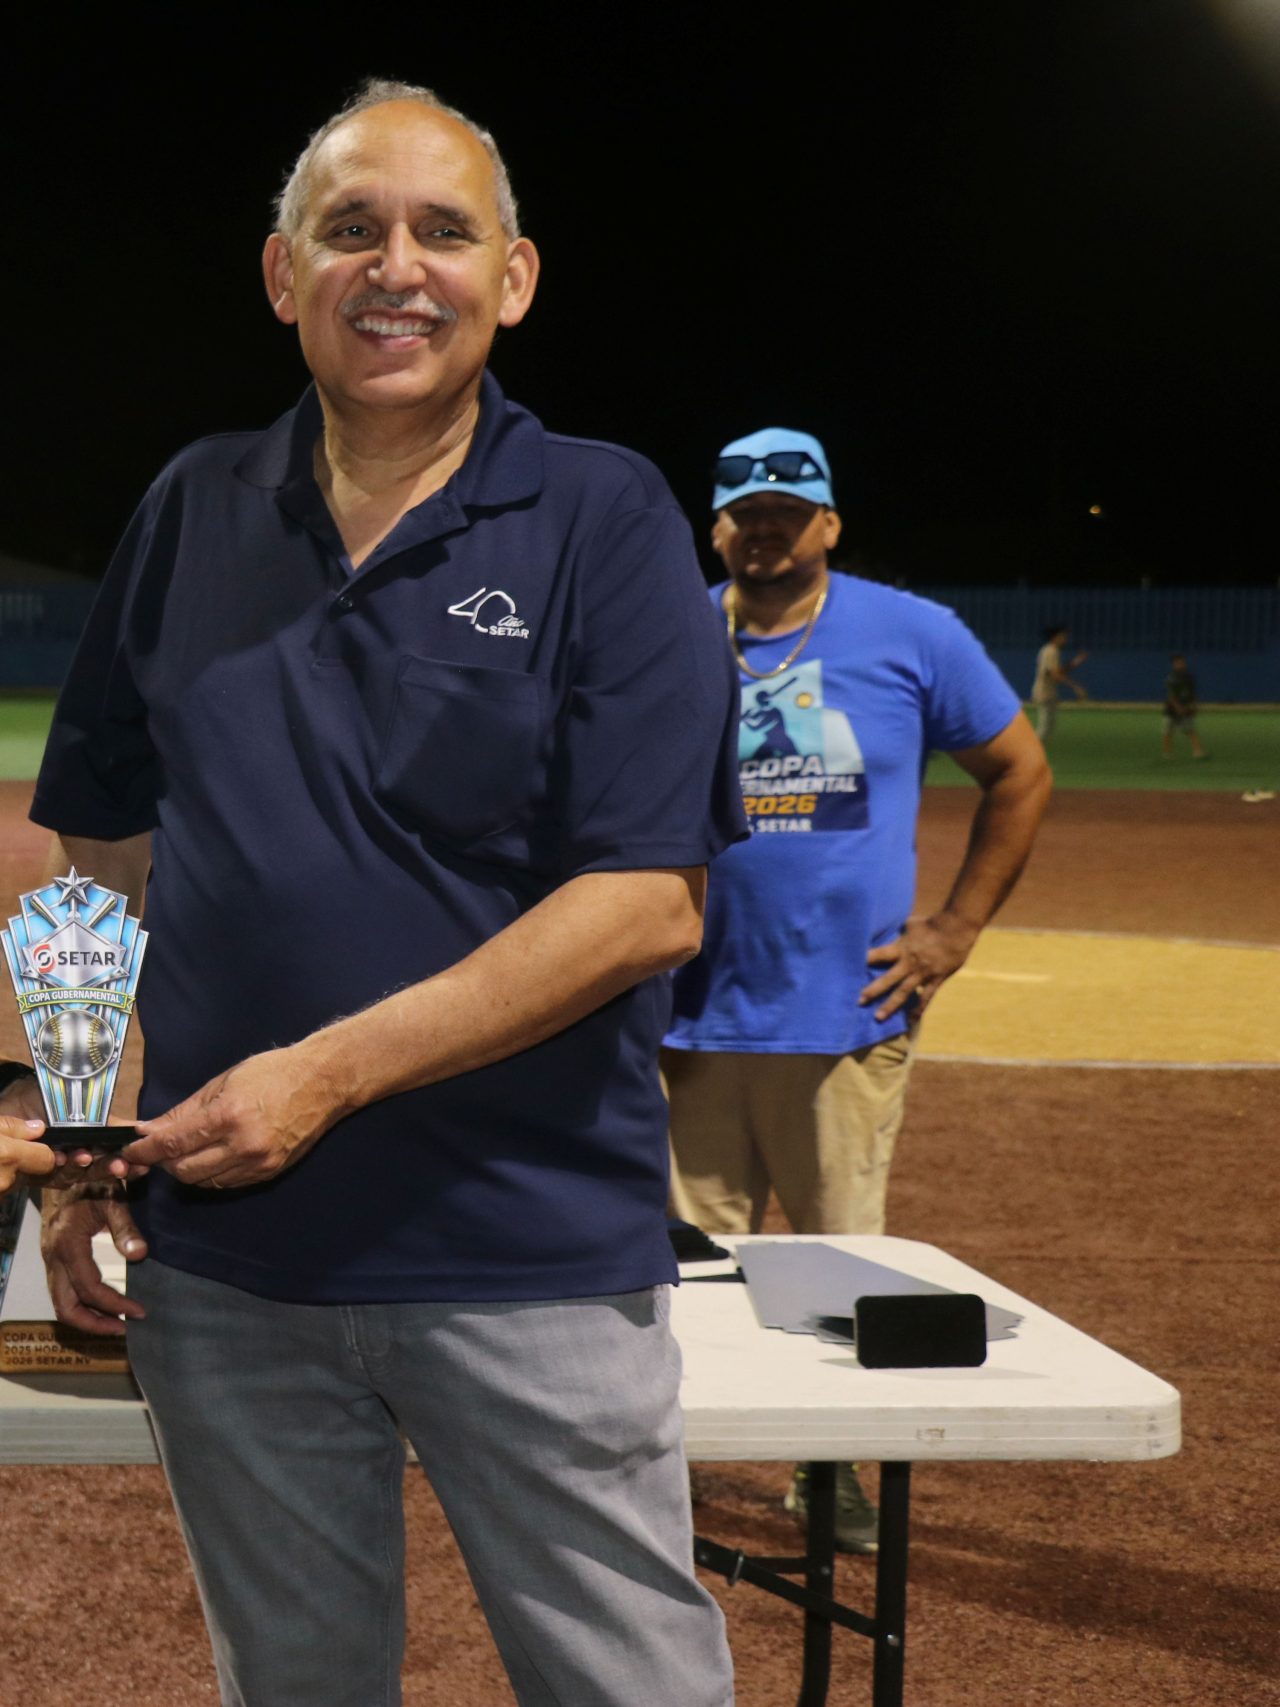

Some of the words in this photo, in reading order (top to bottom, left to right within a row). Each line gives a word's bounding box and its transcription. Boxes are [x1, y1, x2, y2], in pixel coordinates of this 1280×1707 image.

[488, 625, 530, 639] SETAR
[739, 755, 824, 780] COPA
[743, 795, 818, 815] 2026
[756, 818, 813, 832] SETAR
[57, 950, 116, 966] SETAR
[29, 991, 51, 1003] COPA
[51, 989, 121, 1003] GUBERNAMENTAL
[5, 1332, 35, 1342] COPA
[5, 1345, 32, 1356] 2025
[5, 1356, 33, 1366] 2026
[36, 1356, 73, 1365] SETAR
